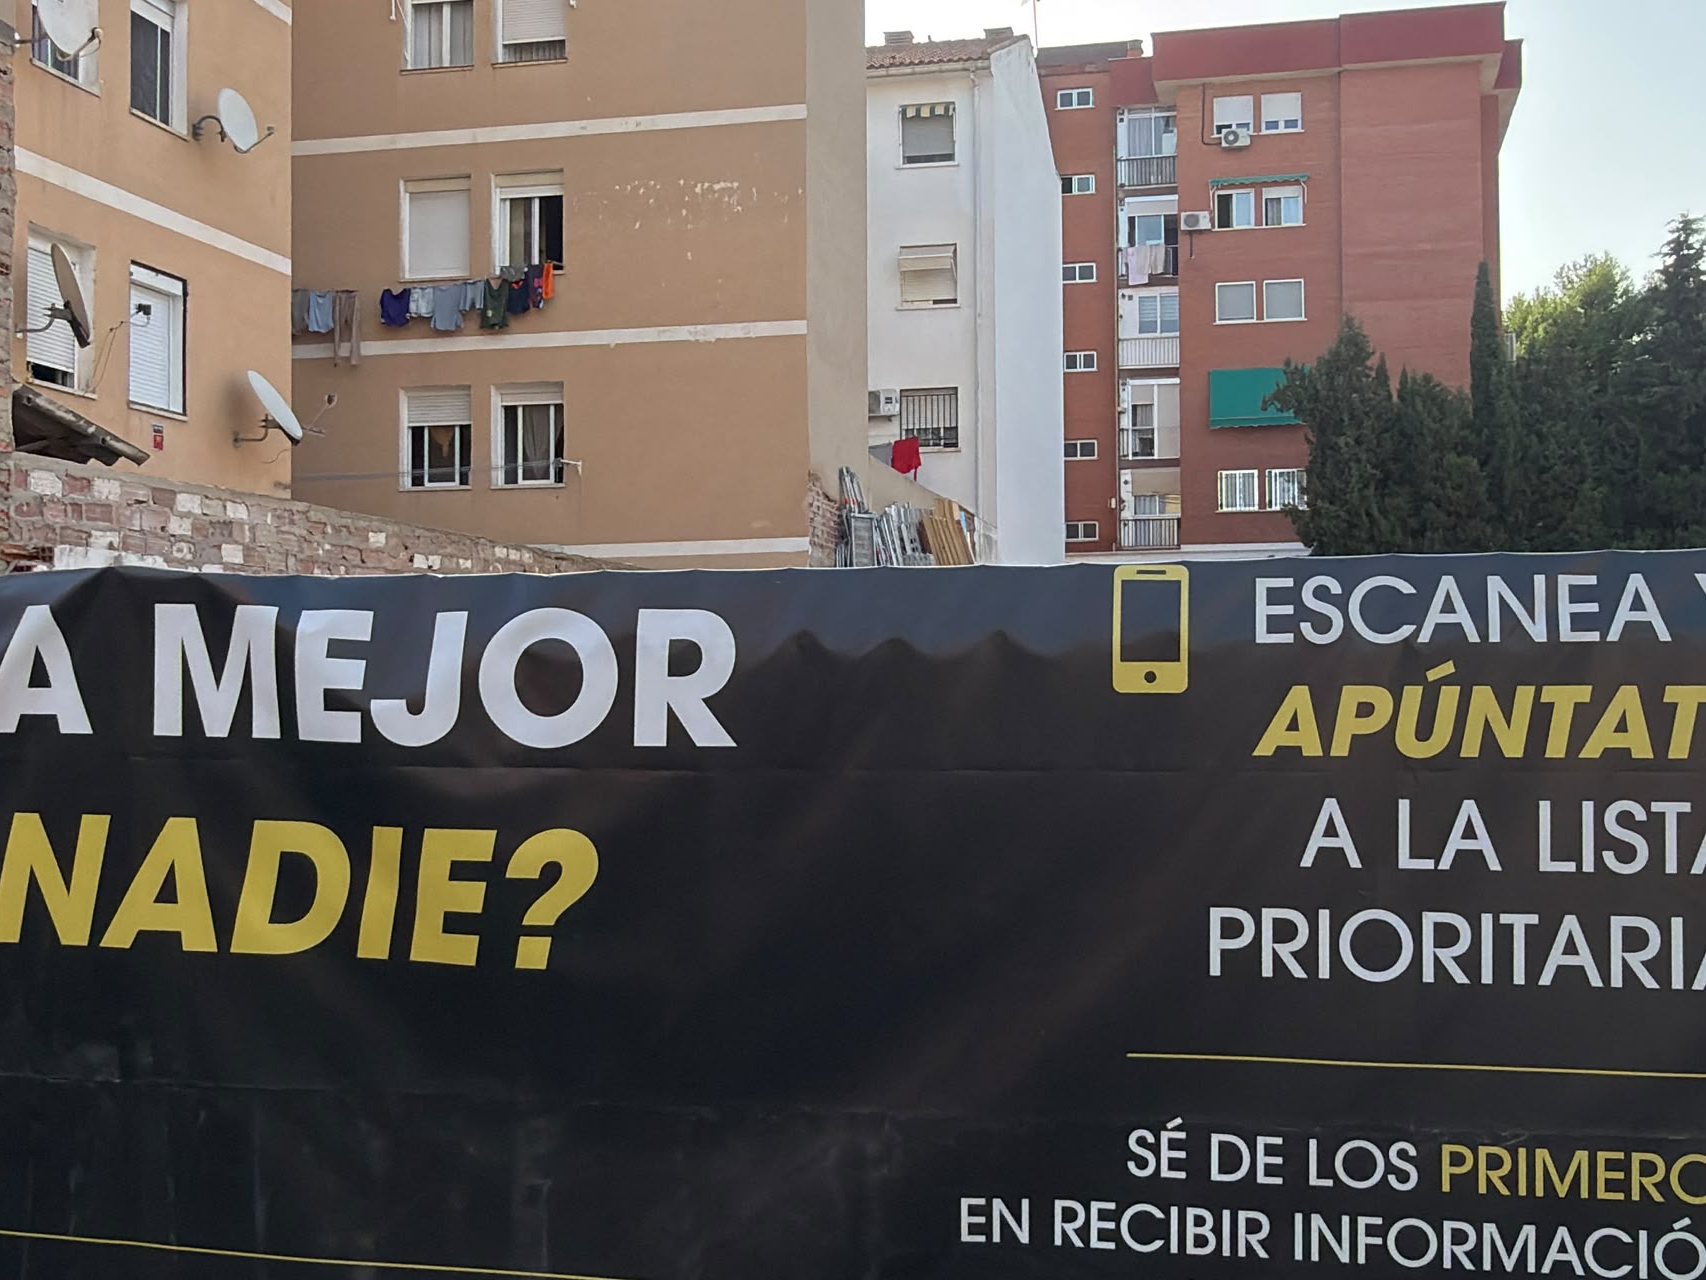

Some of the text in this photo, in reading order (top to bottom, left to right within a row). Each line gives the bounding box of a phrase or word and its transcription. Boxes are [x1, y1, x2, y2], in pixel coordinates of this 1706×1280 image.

[1256, 574, 1671, 644] ESCANEA
[153, 603, 738, 748] MEJOR
[1300, 798, 1362, 868] A
[1399, 799, 1502, 871] LA
[1128, 1117, 1186, 1178] SÉ
[1211, 1133, 1282, 1184] DE
[1309, 1139, 1418, 1190] LOS
[961, 1198, 1029, 1243] EN
[1055, 1200, 1269, 1258] RECIBIR
